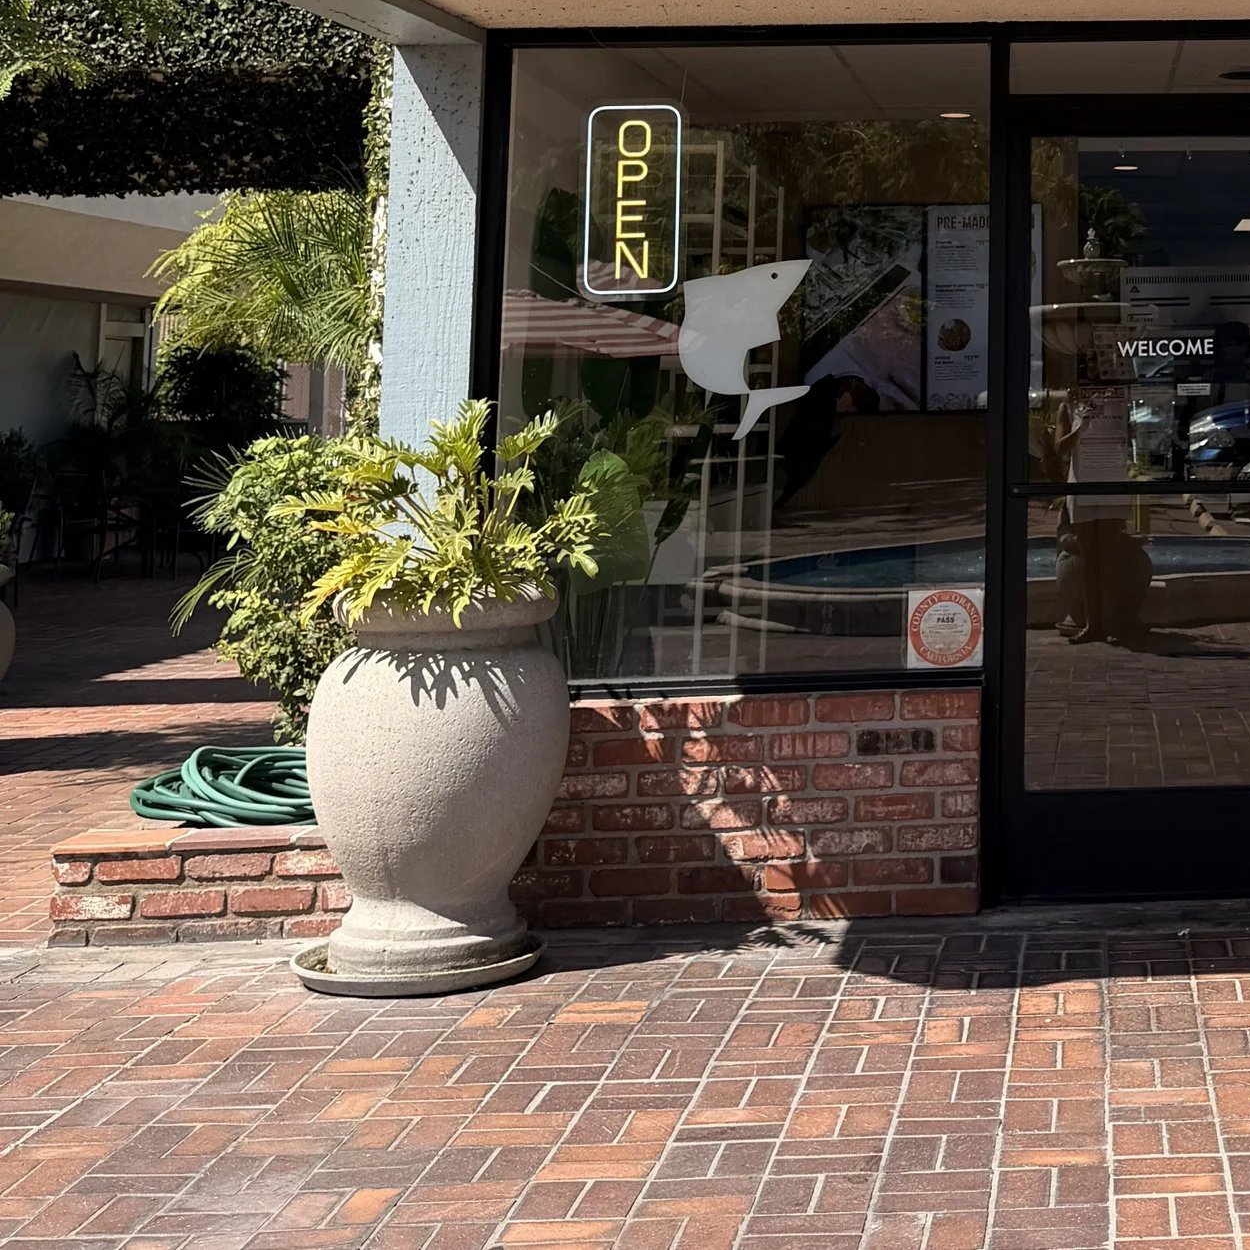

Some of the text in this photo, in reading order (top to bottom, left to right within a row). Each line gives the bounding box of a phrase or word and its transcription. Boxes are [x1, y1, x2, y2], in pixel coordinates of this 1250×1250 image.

[615, 120, 652, 280] OPEN
[1117, 338, 1214, 357] WELCOME
[911, 594, 940, 632] COUNTY
[936, 616, 955, 624] PASS
